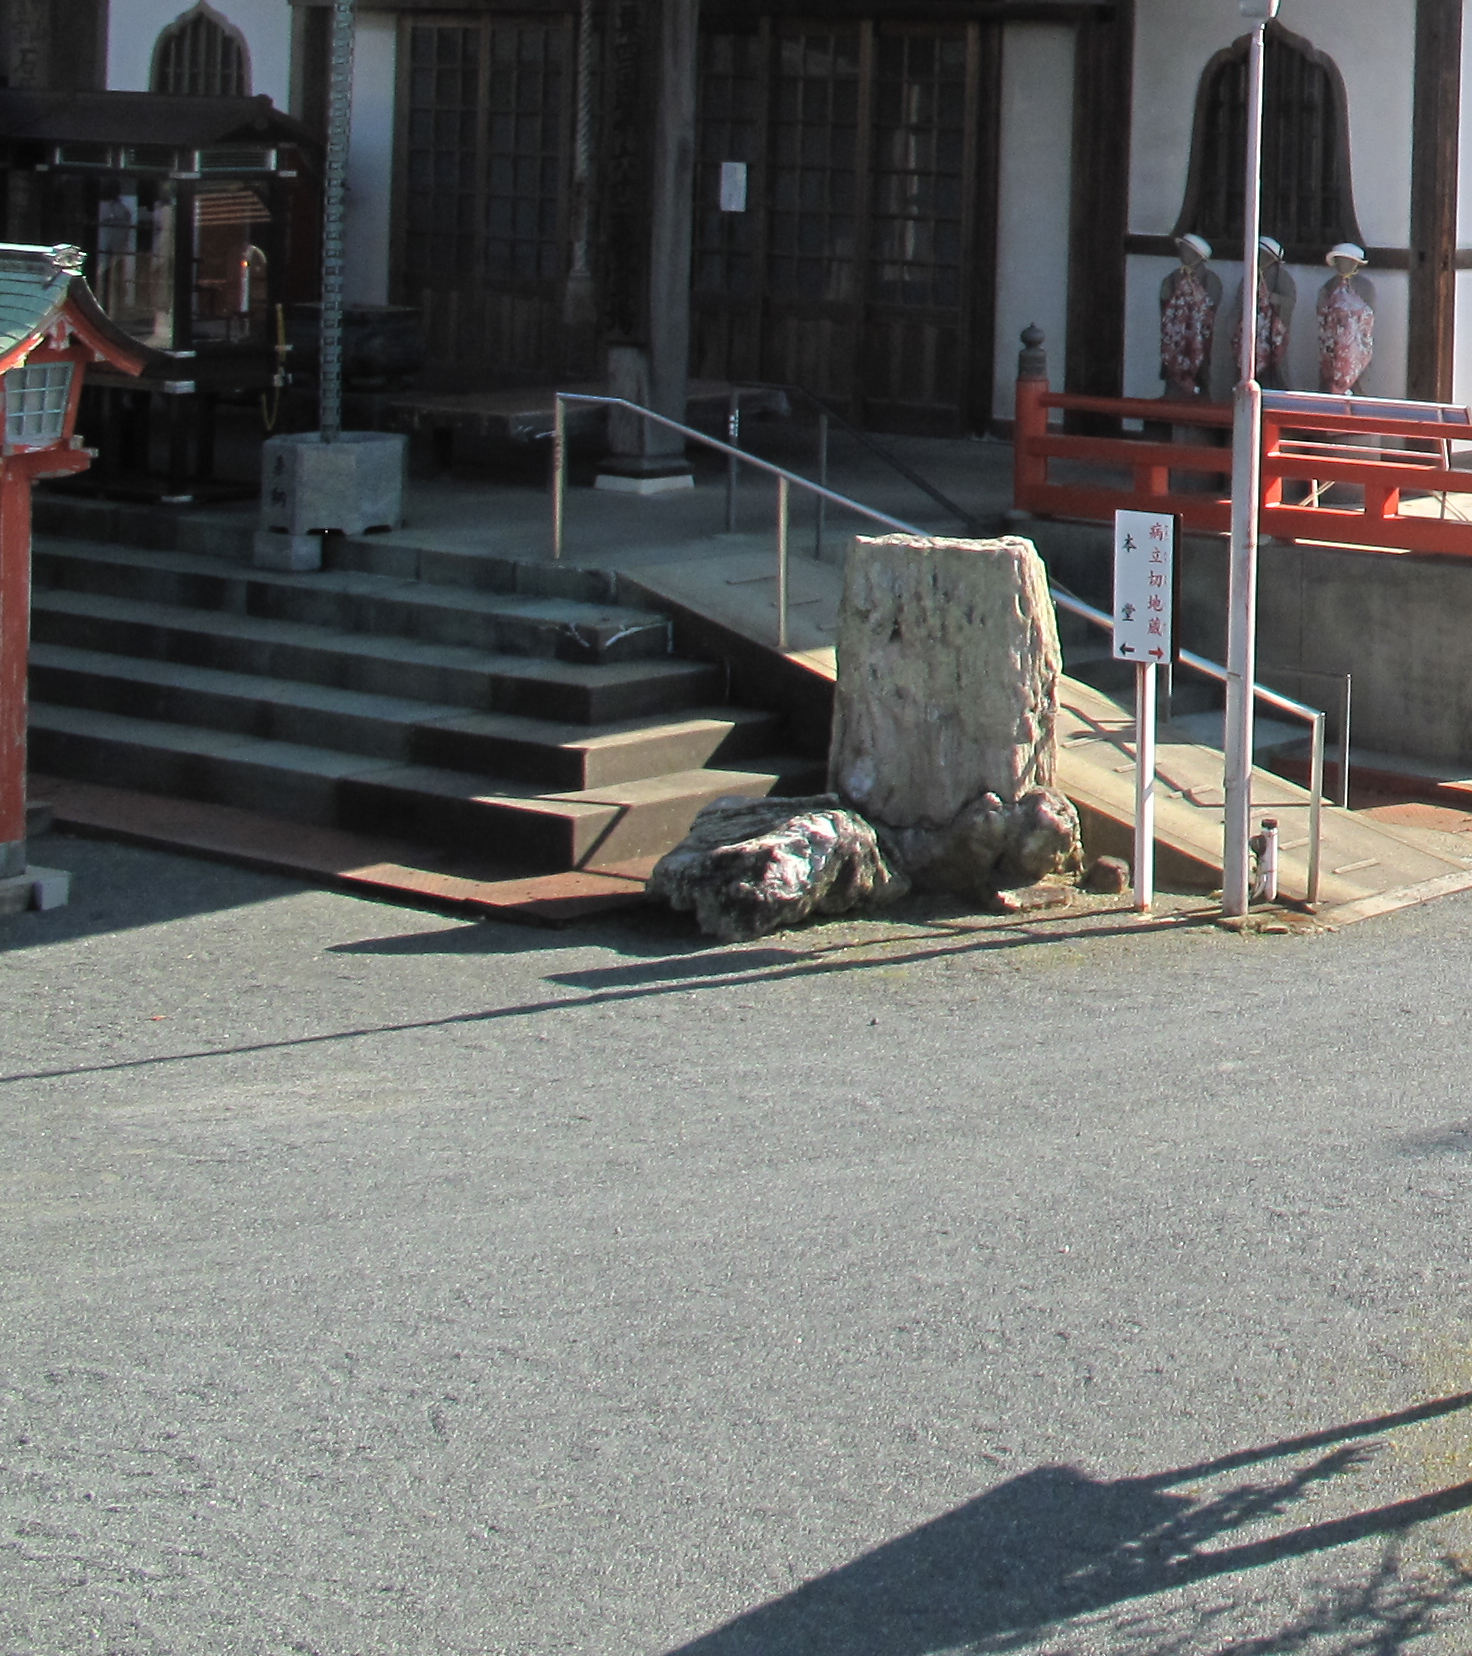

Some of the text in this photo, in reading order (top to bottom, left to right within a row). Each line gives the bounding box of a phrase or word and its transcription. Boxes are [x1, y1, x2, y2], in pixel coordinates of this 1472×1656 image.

[1121, 533, 1137, 622] 本堂
[1147, 522, 1164, 638] 病立切地蔵
